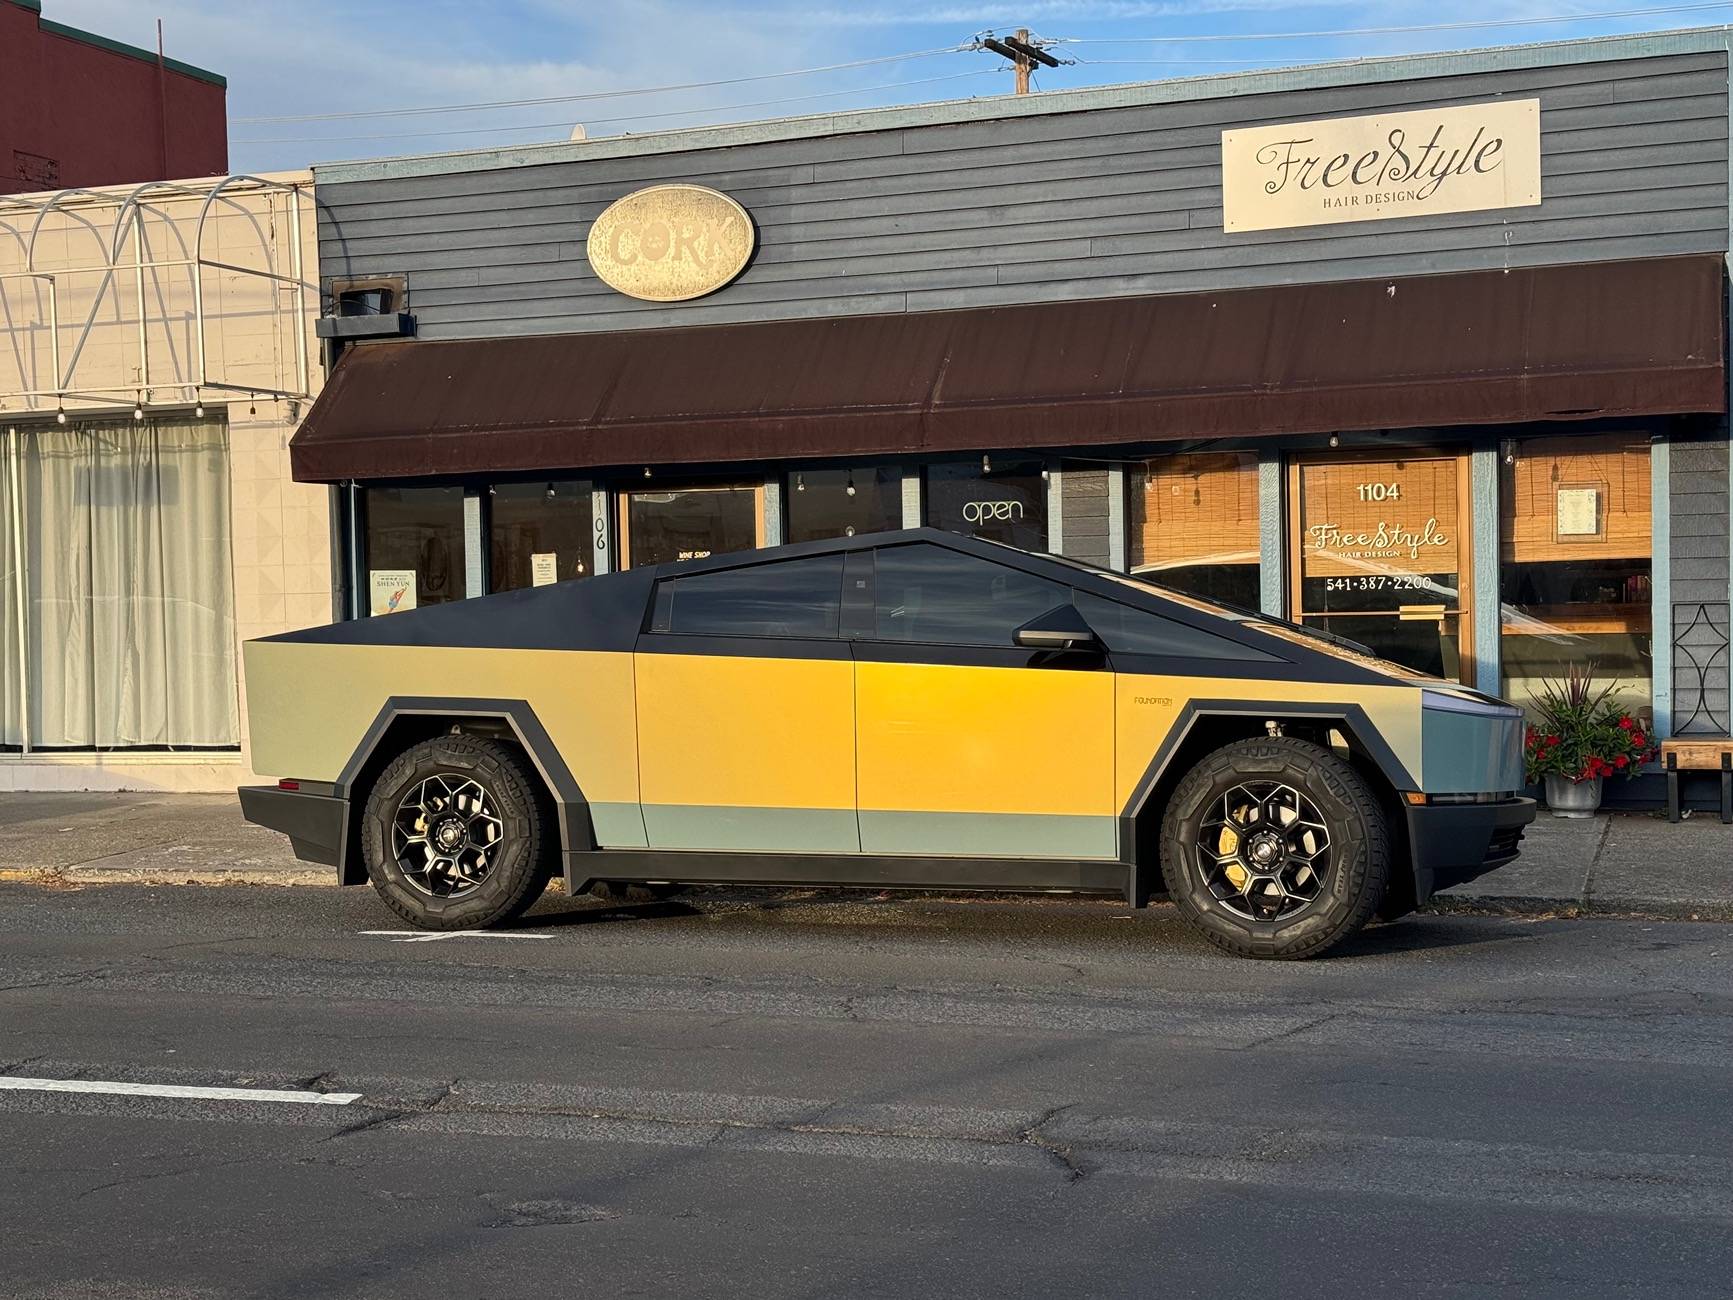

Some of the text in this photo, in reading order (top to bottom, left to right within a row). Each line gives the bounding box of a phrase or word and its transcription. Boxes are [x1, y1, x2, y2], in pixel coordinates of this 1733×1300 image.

[1256, 124, 1504, 201] FreeStyle
[1322, 190, 1416, 209] HAIR DESIGN
[609, 216, 735, 270] CORK
[1356, 483, 1400, 502] 1104
[962, 500, 1024, 527] open
[1310, 517, 1449, 559] FreeStyle
[694, 550, 711, 559] SHOP
[1339, 550, 1401, 559] HAIR DESIGN
